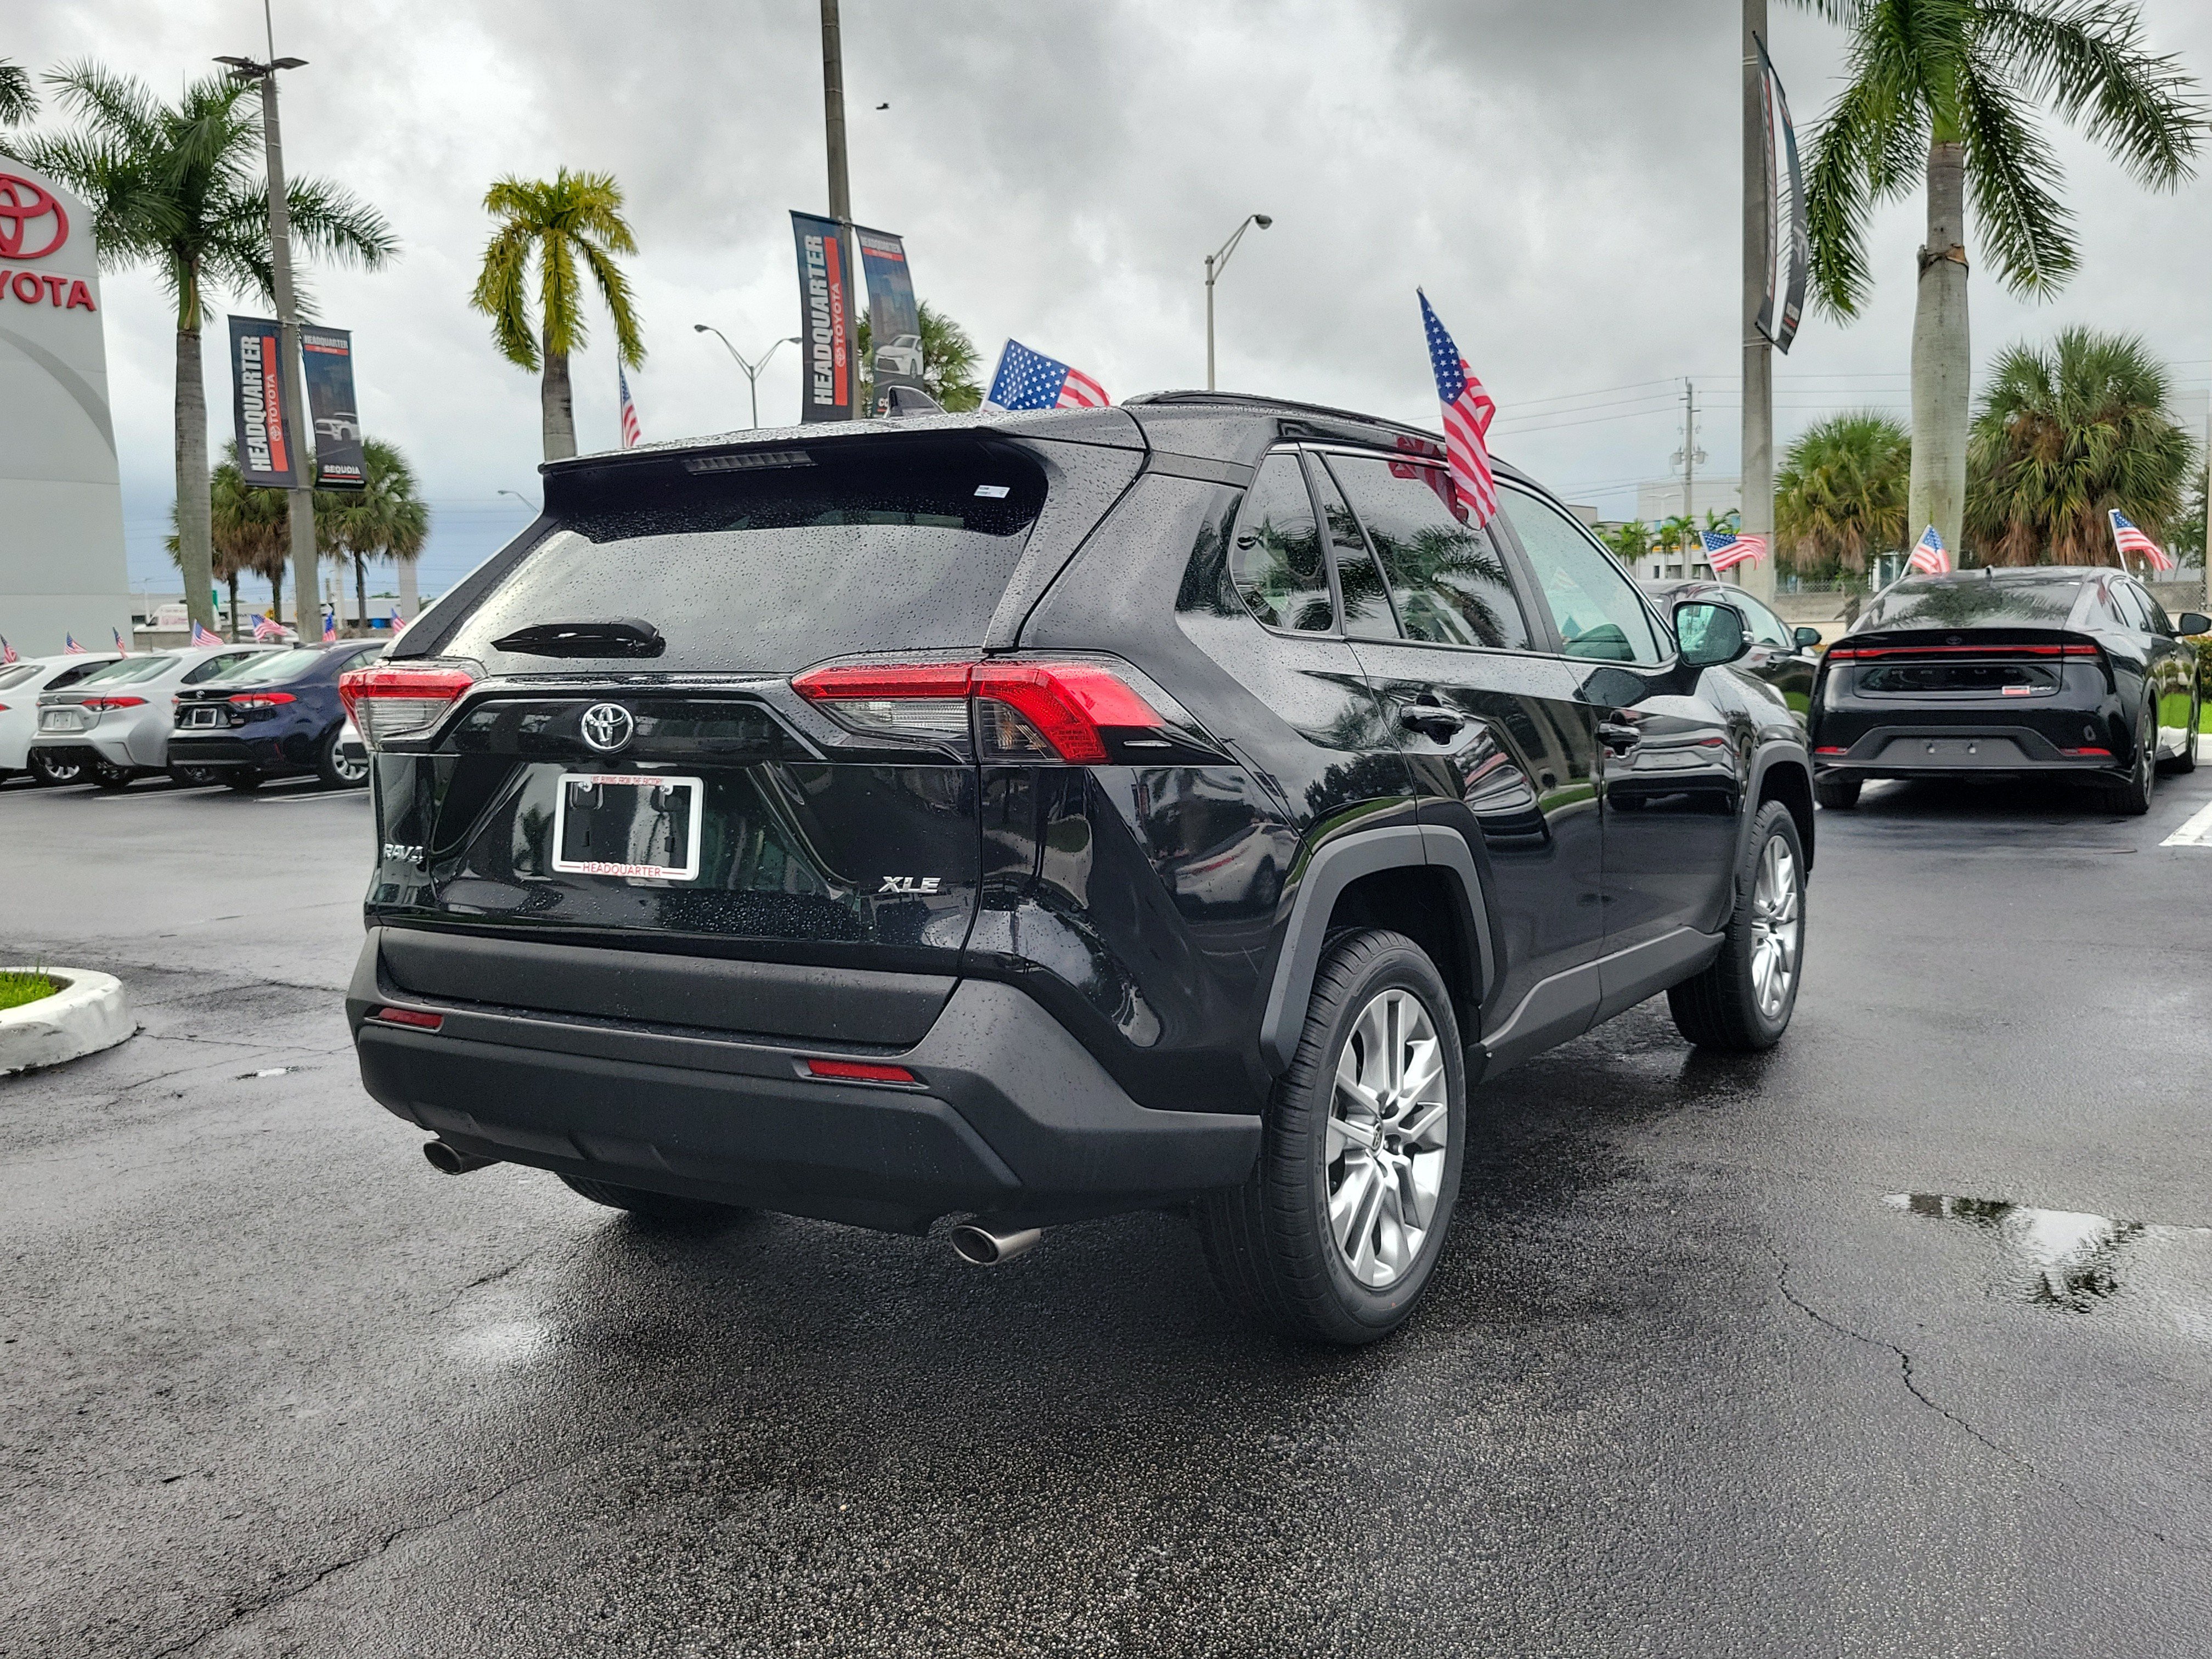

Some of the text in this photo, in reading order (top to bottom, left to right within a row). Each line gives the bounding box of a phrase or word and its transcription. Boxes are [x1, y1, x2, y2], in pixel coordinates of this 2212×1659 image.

[804, 235, 833, 405] HEADQUARTER
[831, 283, 843, 345] TOYOTA
[241, 336, 272, 471] HEADQUARTER
[266, 374, 277, 423] TOYOTA
[324, 464, 361, 475] SEQUOIA
[384, 844, 424, 865] RAV4
[582, 862, 661, 877] HEADQUARTER
[878, 876, 941, 894] XLE
